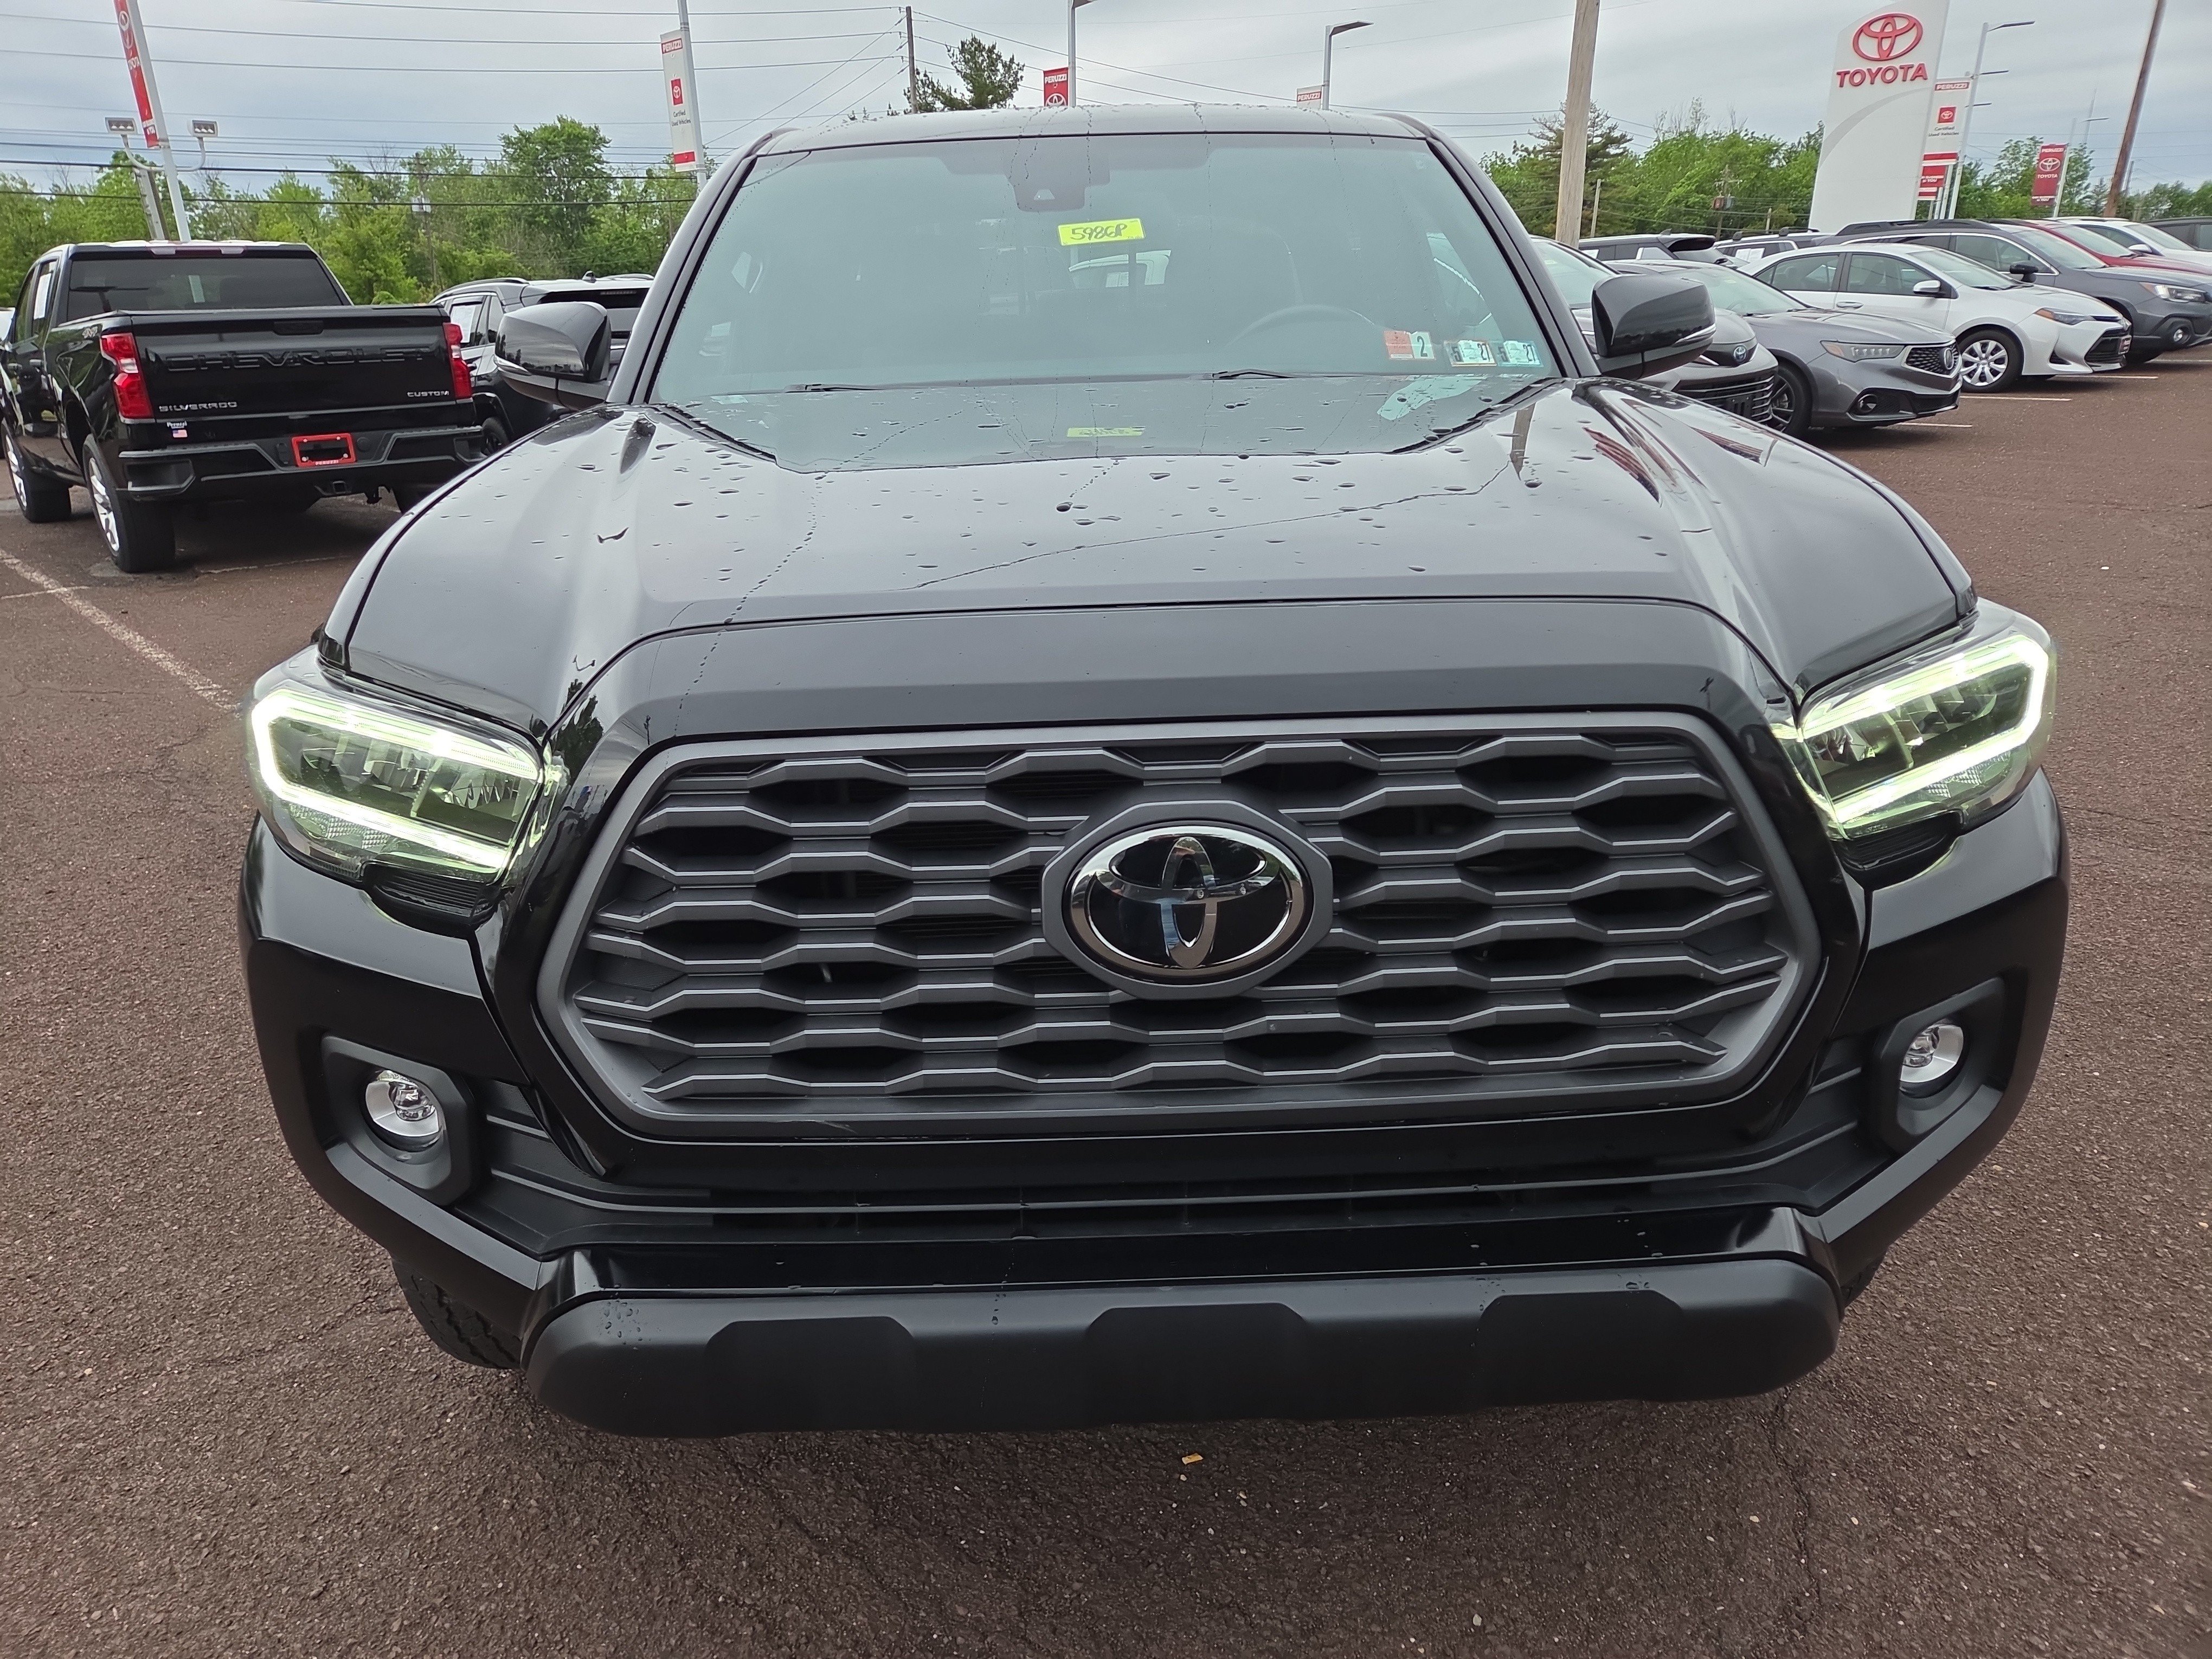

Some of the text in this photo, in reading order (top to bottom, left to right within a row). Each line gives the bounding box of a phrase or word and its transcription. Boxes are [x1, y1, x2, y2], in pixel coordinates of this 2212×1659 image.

[1045, 74, 1067, 83] PERUZZI
[1836, 63, 1928, 88] TOYOTA
[1297, 92, 1320, 101] PERUZZI
[1071, 223, 1128, 240] 5986P
[1417, 336, 1428, 357] 2
[165, 348, 430, 371] CHEVROLET
[159, 402, 237, 412] SILVERADO
